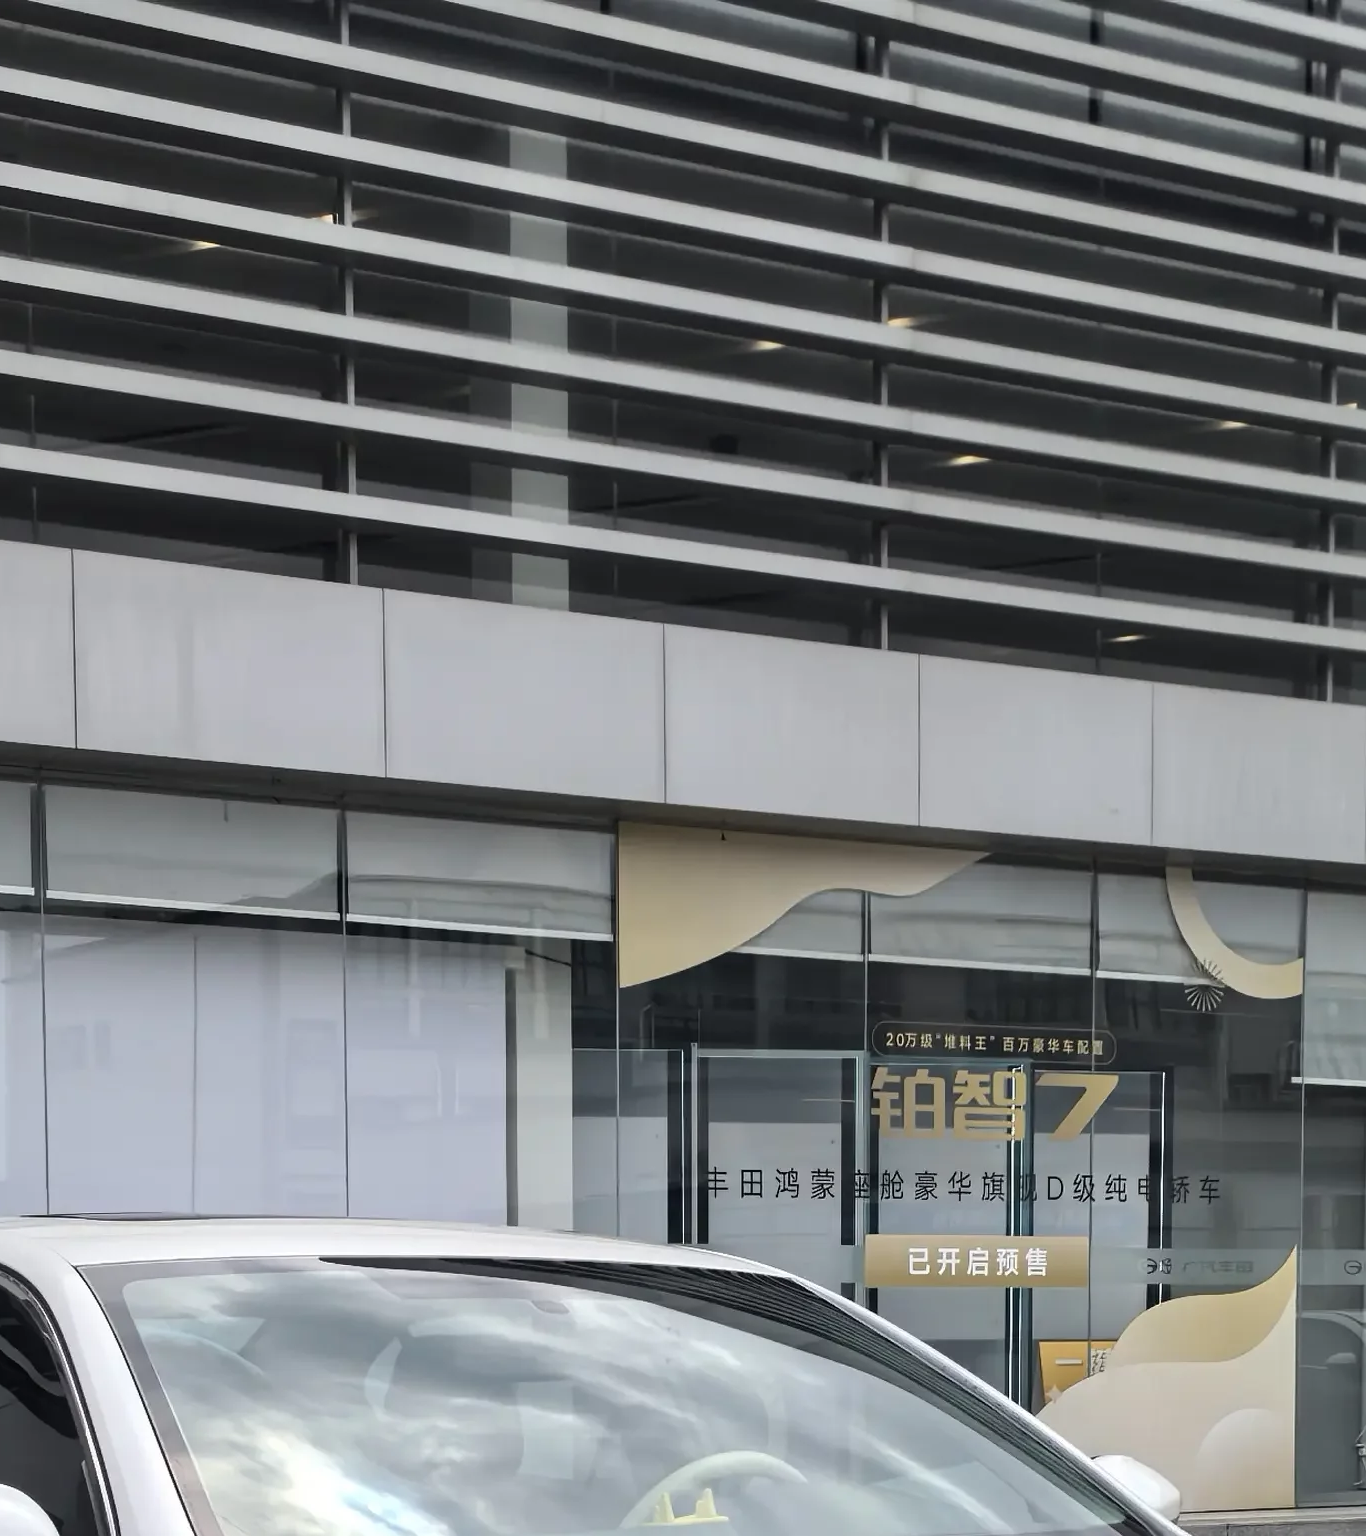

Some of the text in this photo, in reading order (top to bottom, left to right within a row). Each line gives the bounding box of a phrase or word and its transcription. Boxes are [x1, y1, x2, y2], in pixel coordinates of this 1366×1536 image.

[870, 1066, 1120, 1142] 铂智7
[908, 1247, 1048, 1277] 已开启预售
